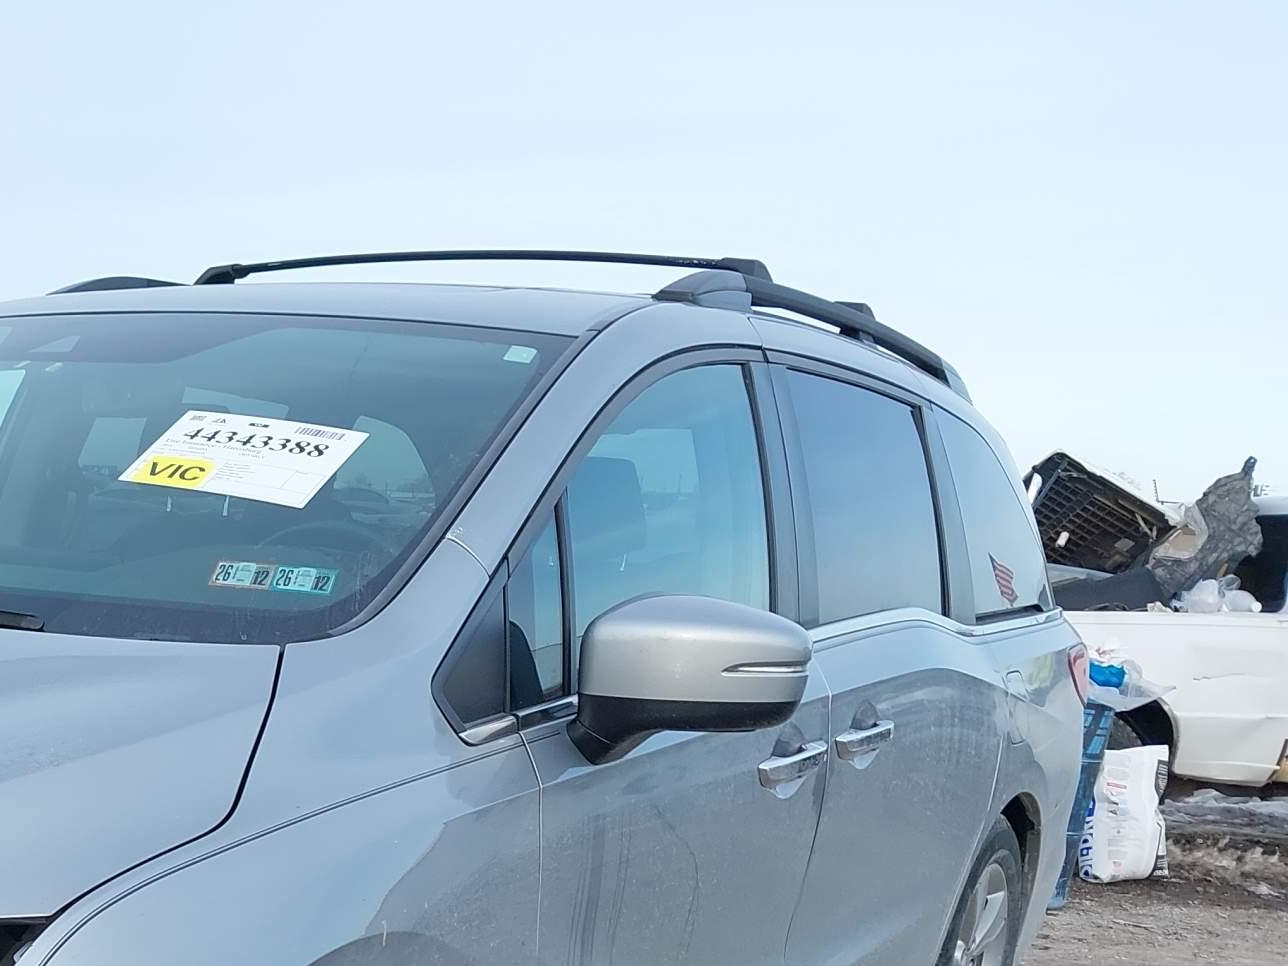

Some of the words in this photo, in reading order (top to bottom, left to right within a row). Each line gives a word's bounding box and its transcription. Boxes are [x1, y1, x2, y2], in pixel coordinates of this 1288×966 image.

[184, 427, 330, 458] 44343388
[149, 461, 206, 481] VIC
[215, 564, 233, 581] 26
[252, 570, 269, 586] 12
[275, 569, 294, 587] 26
[313, 575, 331, 591] 12
